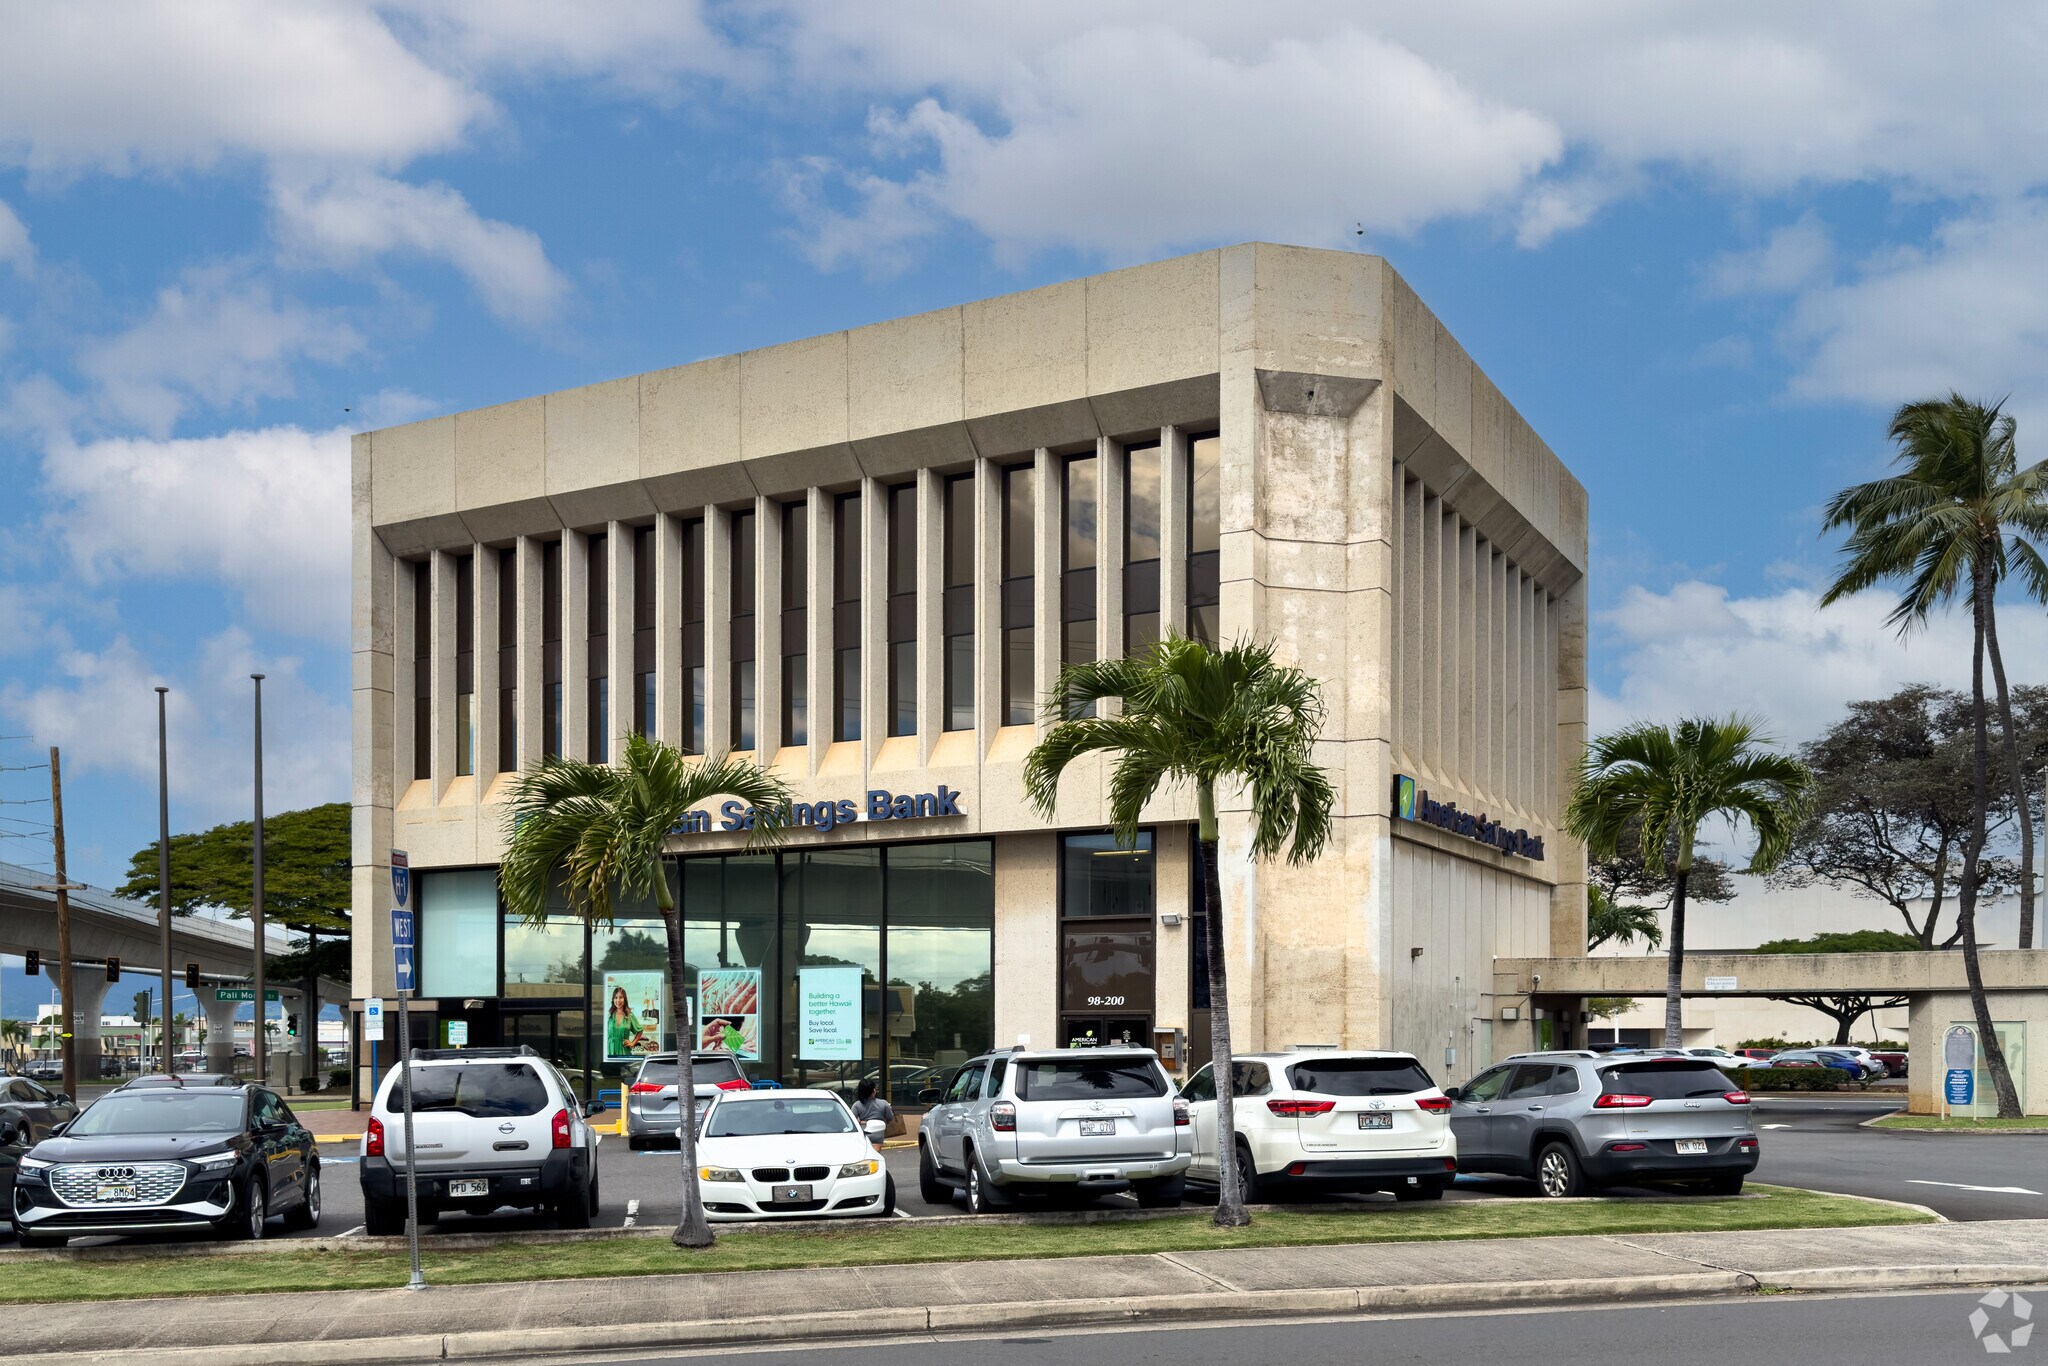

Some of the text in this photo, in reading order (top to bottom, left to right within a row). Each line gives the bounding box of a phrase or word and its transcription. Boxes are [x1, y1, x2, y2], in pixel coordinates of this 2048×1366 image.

[867, 785, 961, 821] Bank
[1415, 790, 1476, 838] American
[1515, 828, 1545, 861] Bank
[394, 918, 411, 938] WEST
[220, 991, 237, 999] Pali
[241, 991, 255, 999] Mo
[1087, 996, 1124, 1006] 98-200
[472, 1182, 487, 1191] 562
